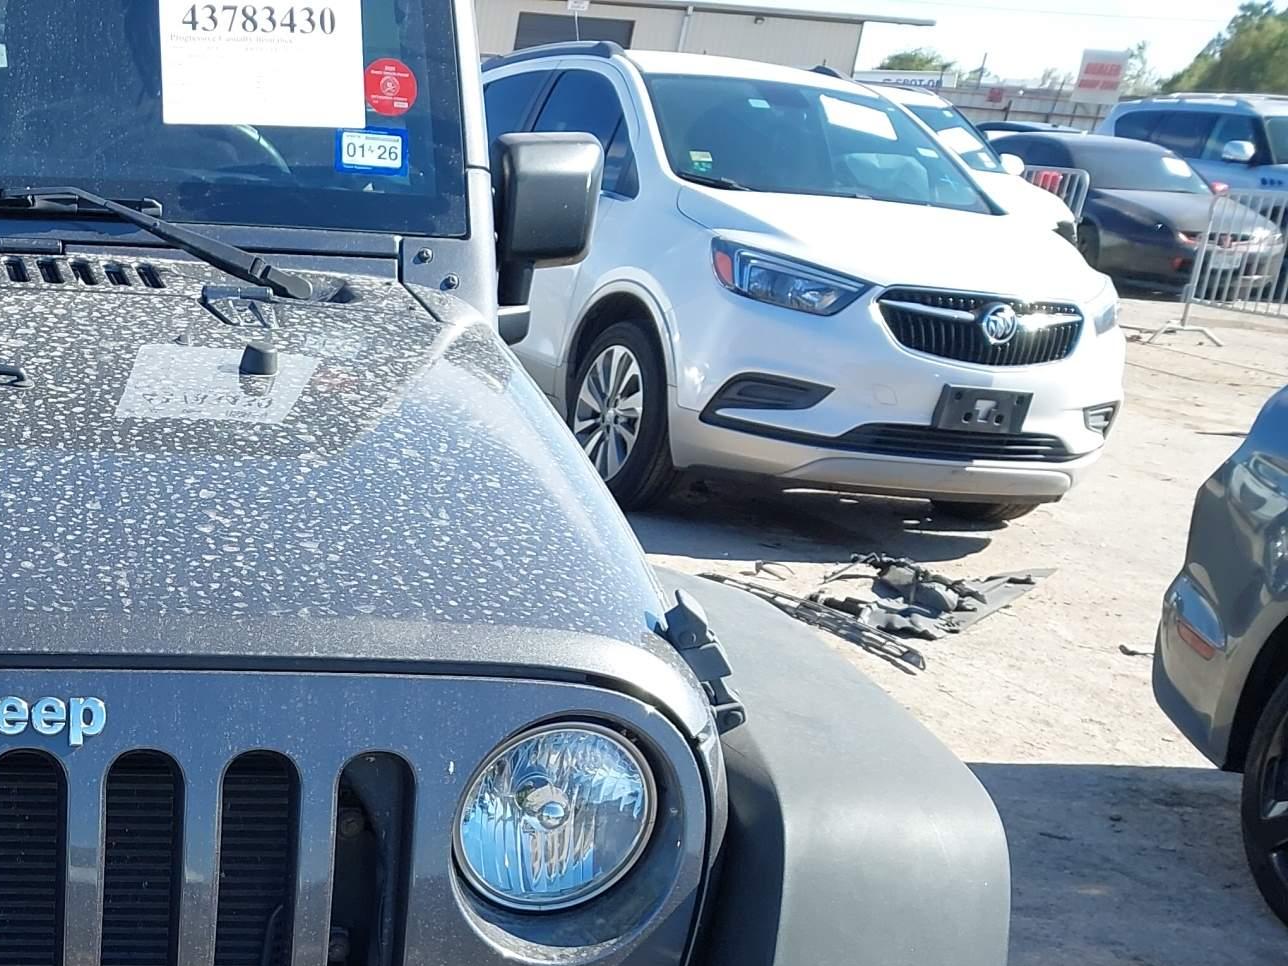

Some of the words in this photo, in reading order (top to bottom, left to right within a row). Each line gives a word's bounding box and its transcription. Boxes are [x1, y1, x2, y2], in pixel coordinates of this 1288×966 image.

[181, 4, 337, 35] 43783430
[346, 142, 365, 158] 01
[376, 145, 399, 161] 26
